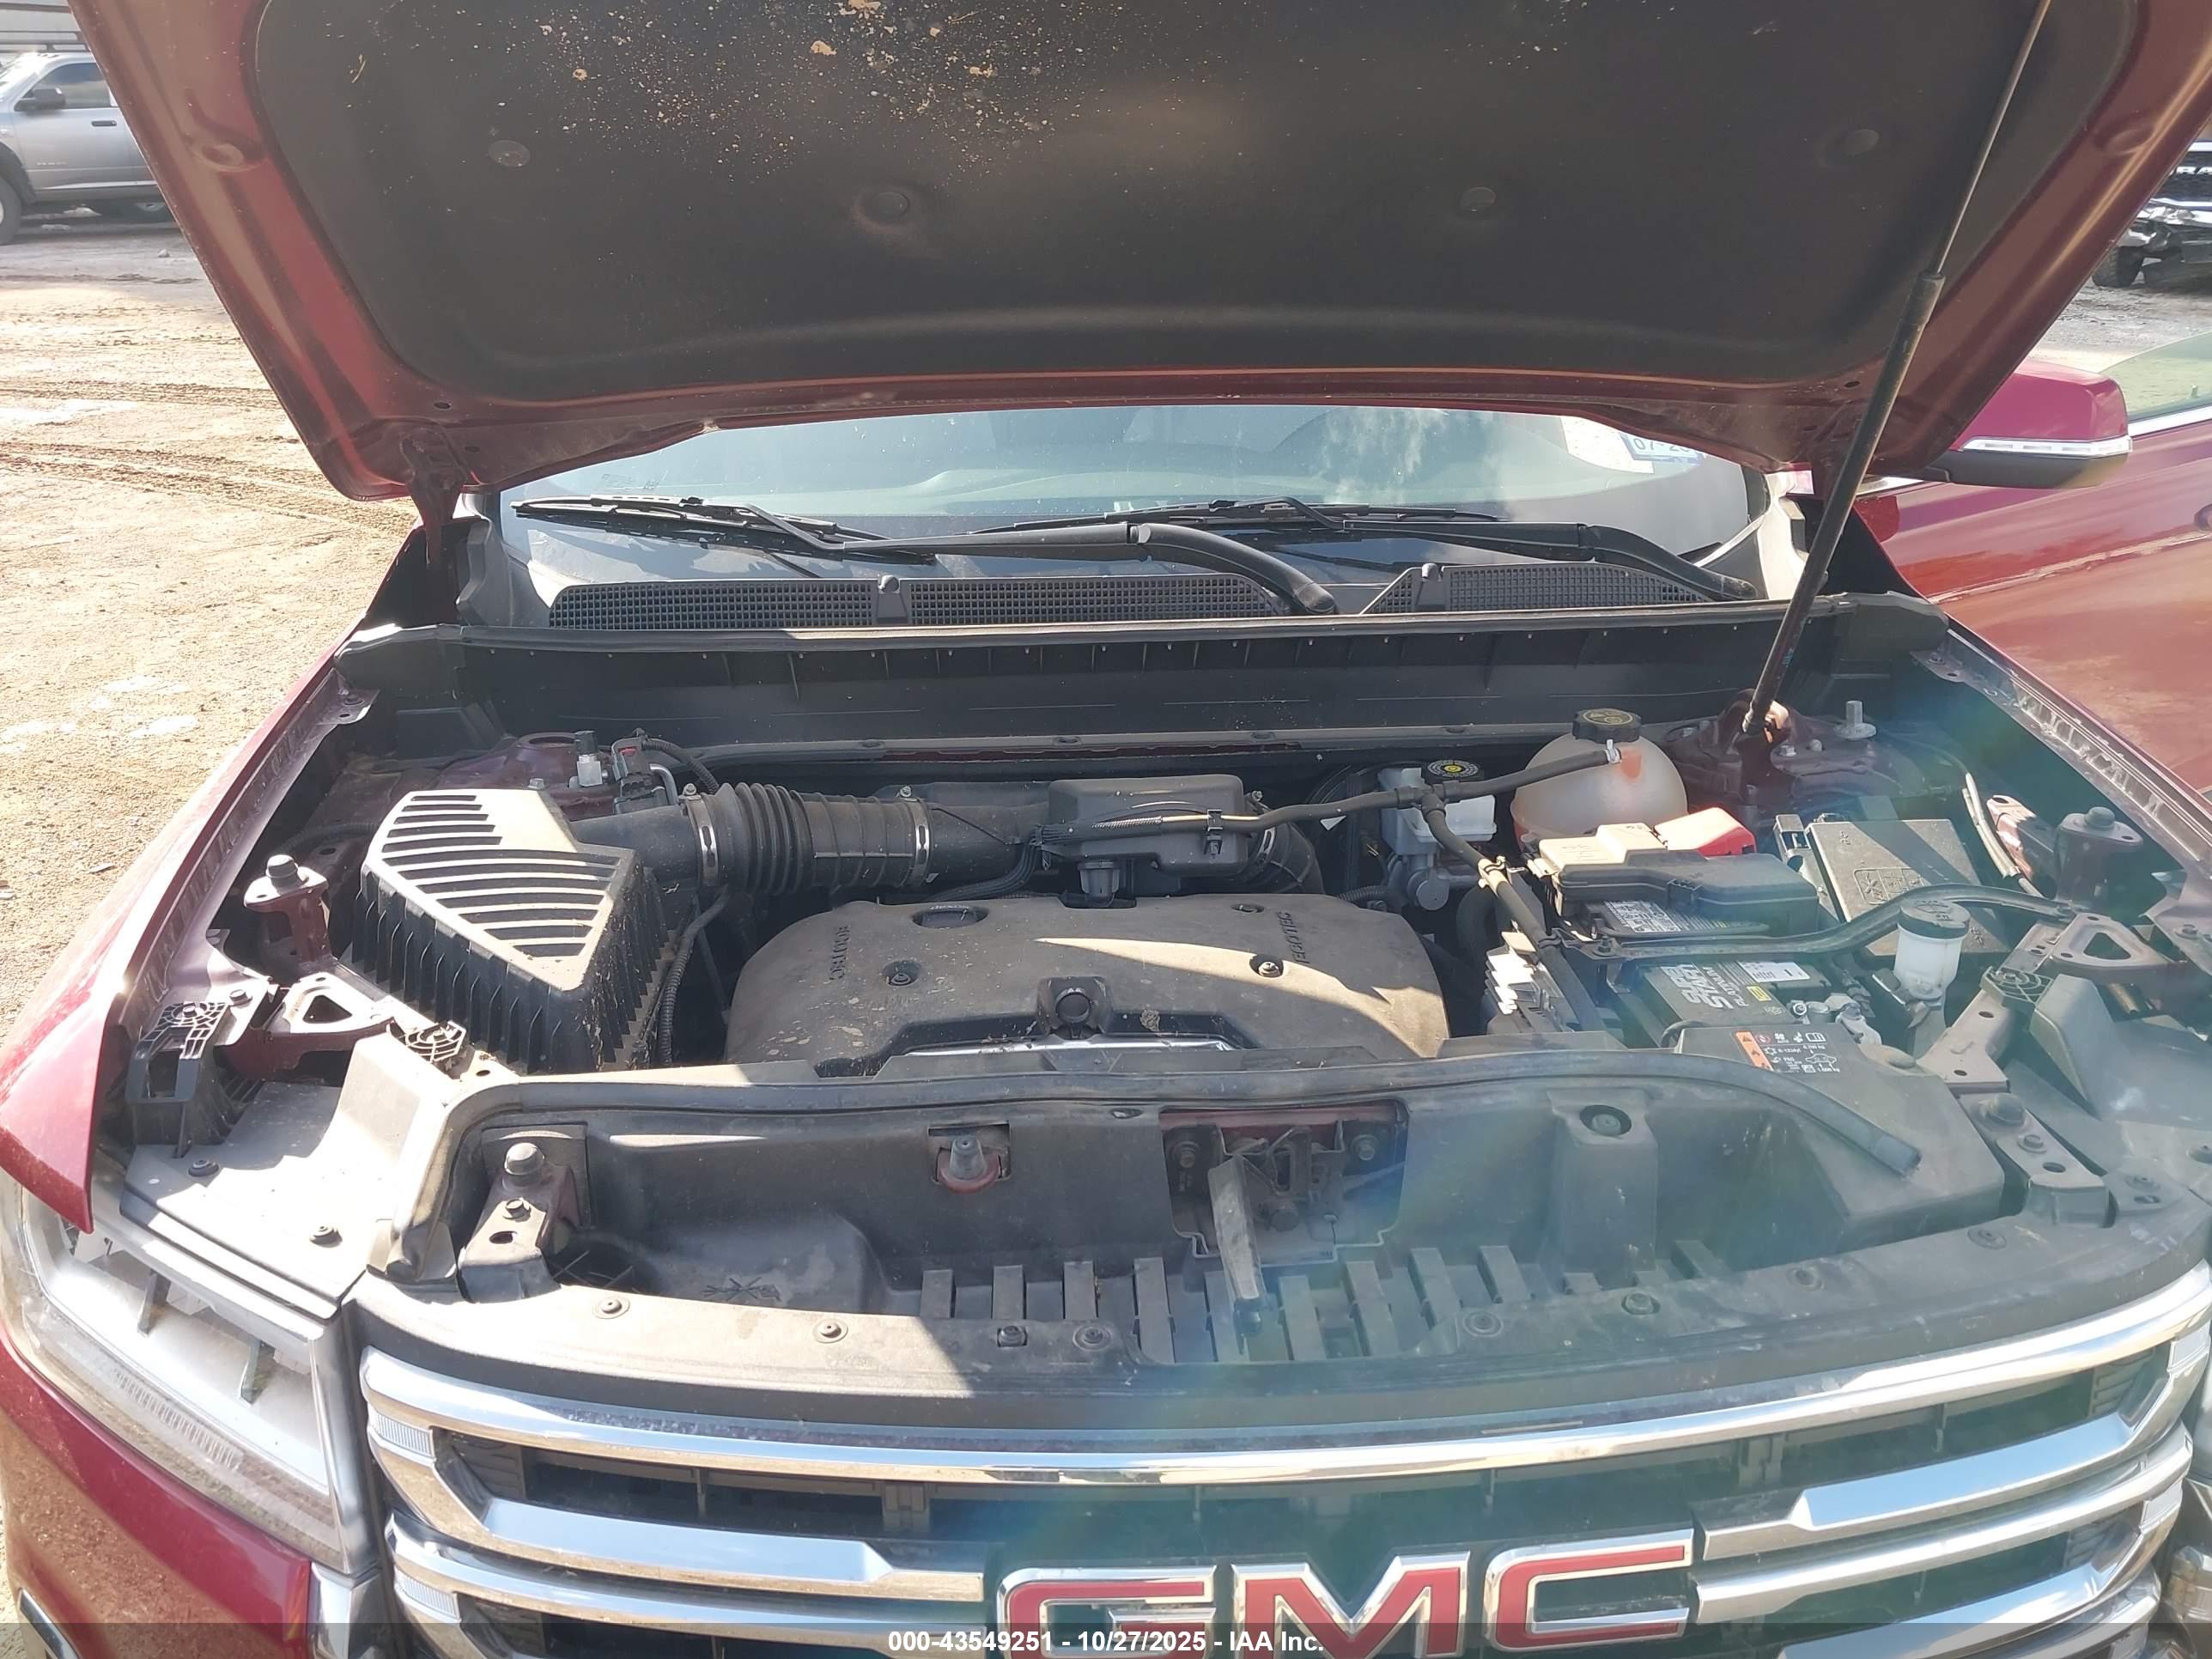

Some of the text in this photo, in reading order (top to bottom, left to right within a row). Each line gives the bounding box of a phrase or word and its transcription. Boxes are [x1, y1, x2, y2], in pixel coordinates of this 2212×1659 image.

[1275, 911, 1310, 964] ECOTEC
[1677, 963, 1734, 1009] START
[1702, 967, 1749, 1006] PLATINUM
[997, 1528, 1695, 1659] GMC
